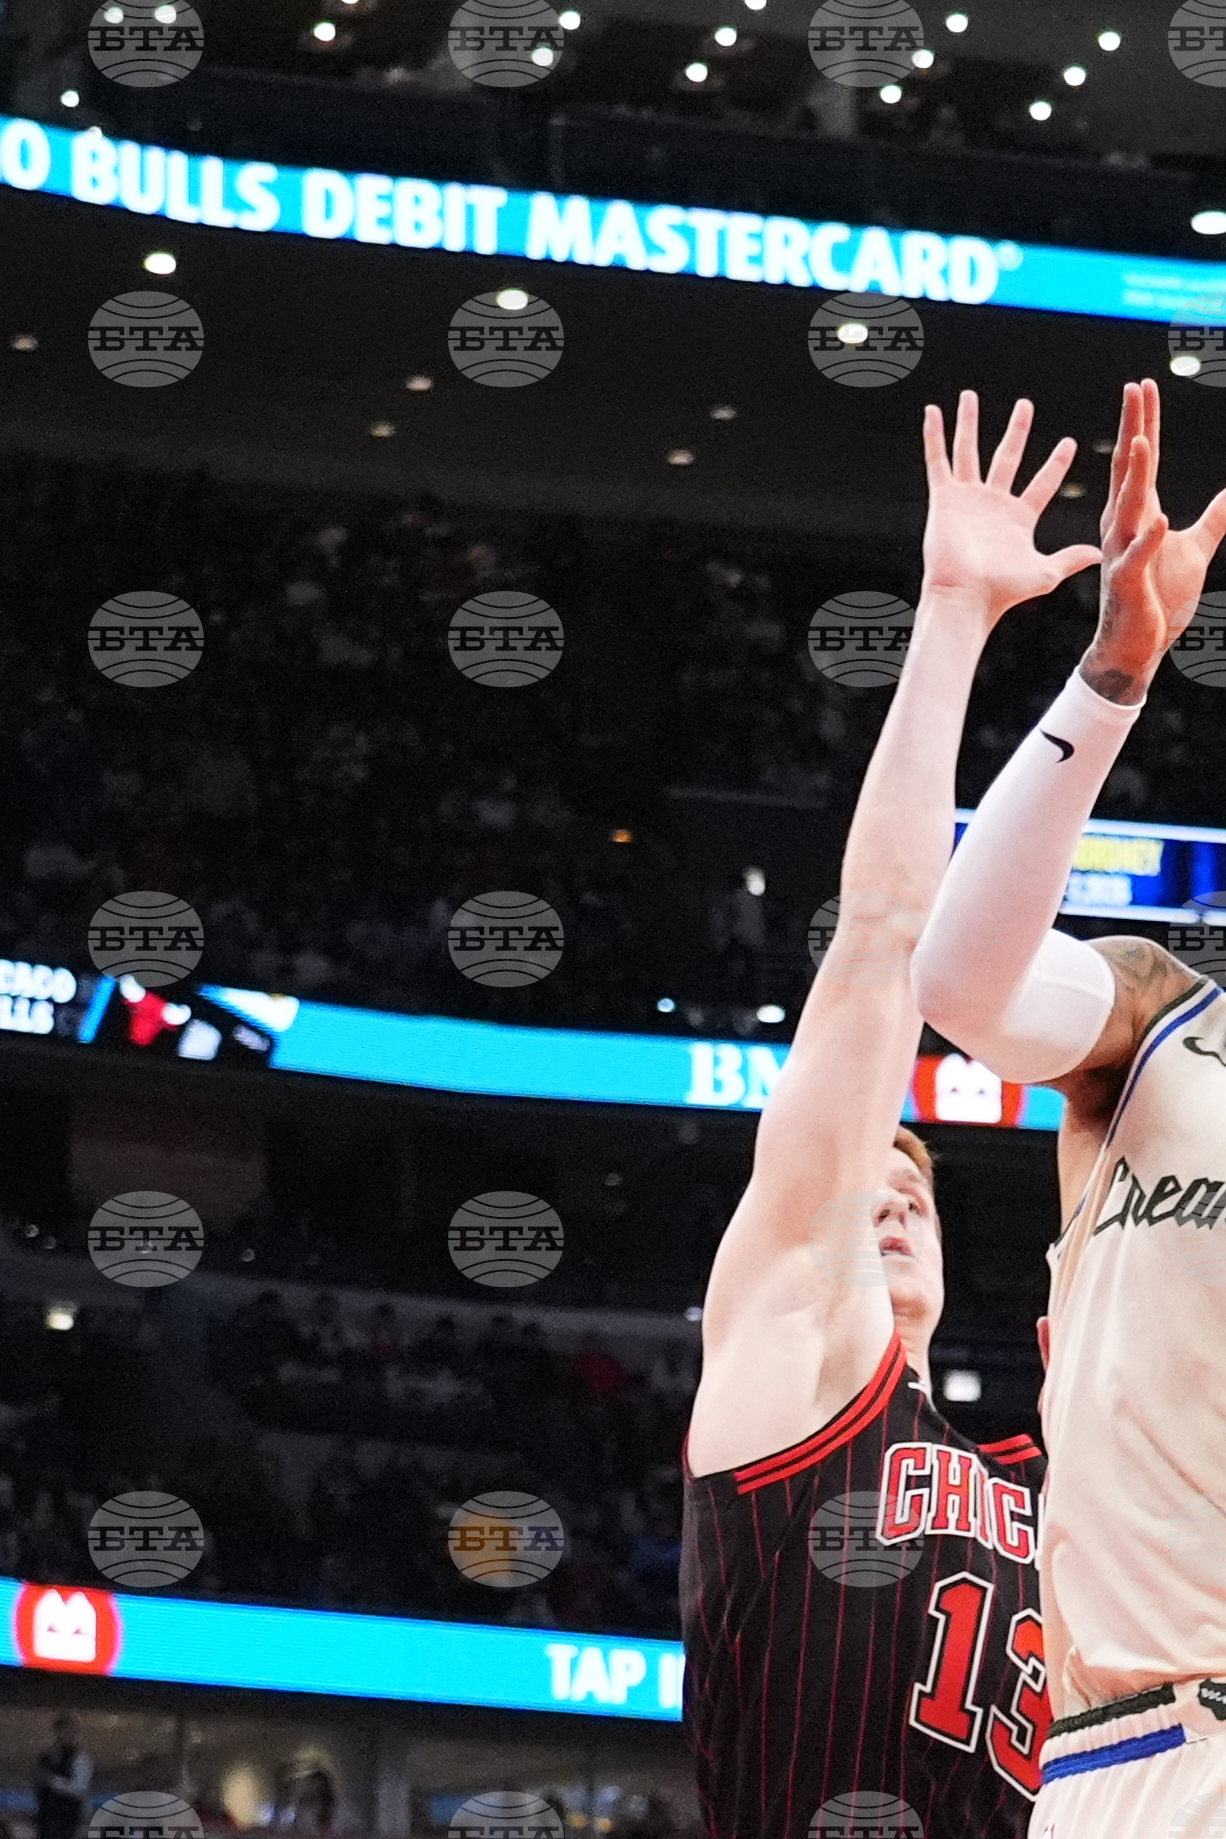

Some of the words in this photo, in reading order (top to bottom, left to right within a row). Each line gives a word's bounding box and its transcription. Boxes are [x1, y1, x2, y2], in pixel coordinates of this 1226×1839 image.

[70, 132, 281, 232] BULLS
[301, 167, 508, 255] DEBIT
[875, 1441, 1044, 1571] CHIC
[546, 1643, 647, 1705] TAP
[908, 1571, 1054, 1802] 13
